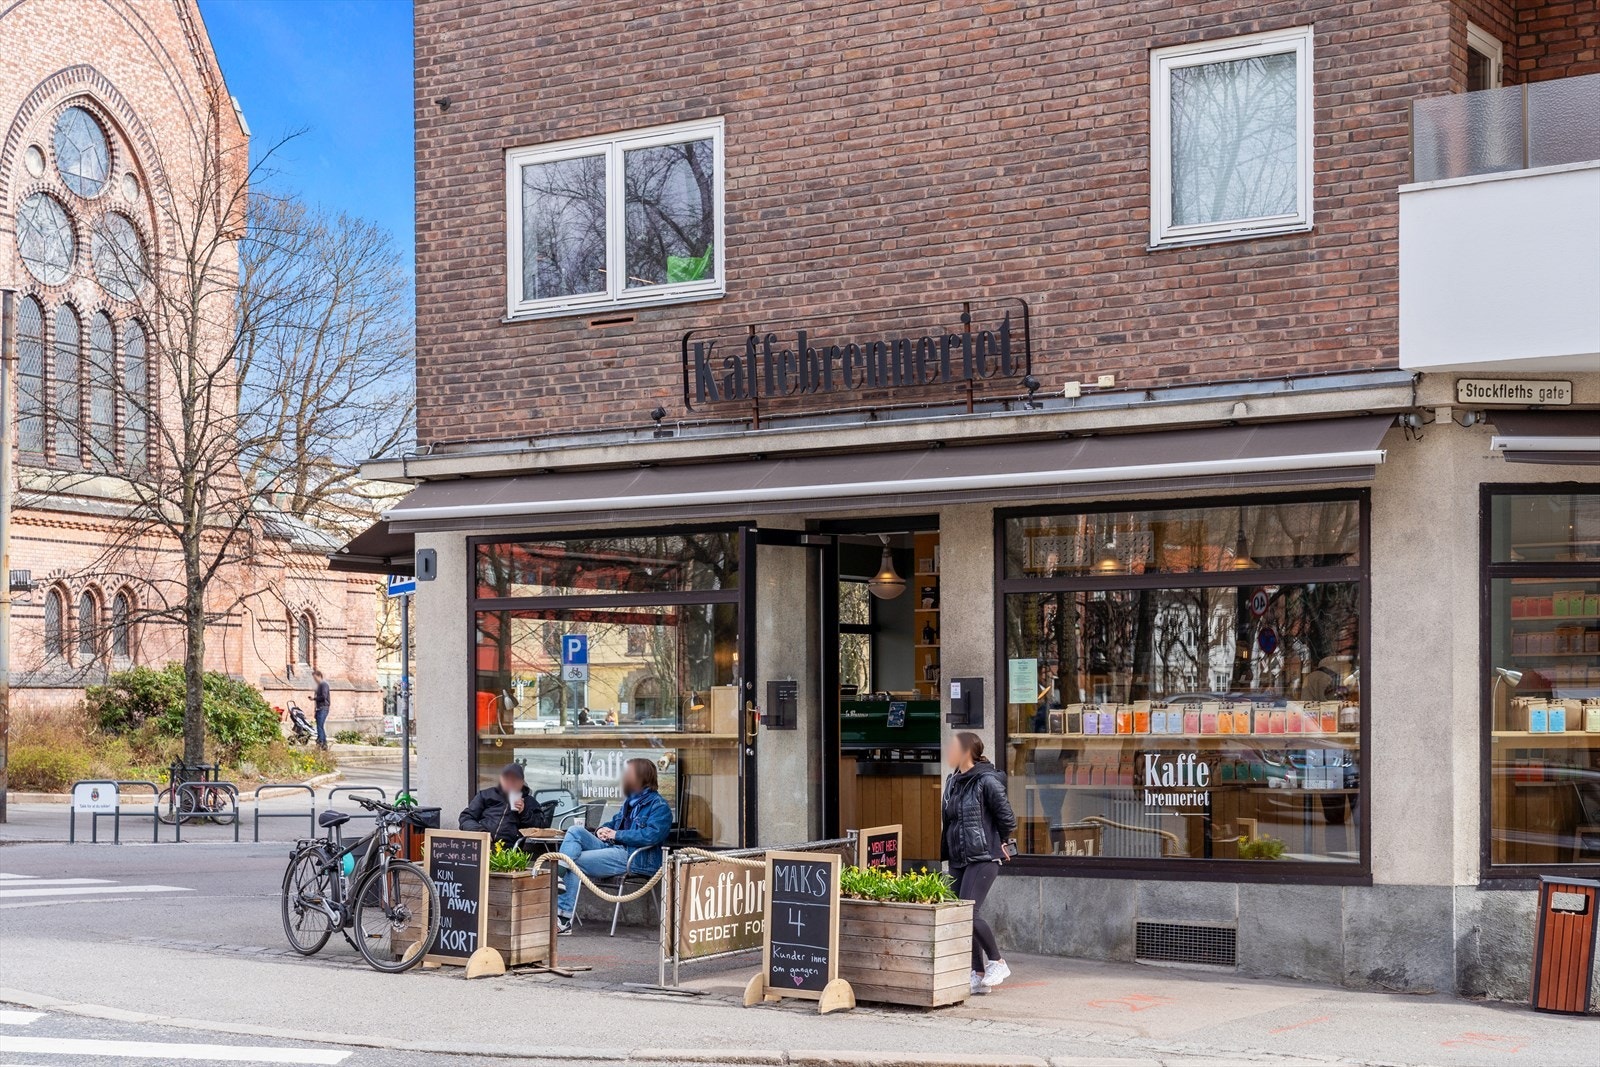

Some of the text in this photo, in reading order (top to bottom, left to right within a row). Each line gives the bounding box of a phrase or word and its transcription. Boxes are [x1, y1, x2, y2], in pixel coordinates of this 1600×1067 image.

[692, 310, 1019, 404] Kaffebrenneriet
[1466, 383, 1564, 402] Stockfleths gate
[568, 638, 582, 661] P
[1144, 753, 1209, 787] Kaffe
[1144, 789, 1210, 806] brenneriet
[437, 869, 454, 881] KUN
[774, 865, 827, 897] MAKS
[447, 897, 477, 914] AWAY
[688, 922, 739, 944] STEDET
[788, 907, 806, 937] 4
[440, 928, 477, 952] KORT
[772, 944, 827, 965] Kunder inne
[789, 967, 819, 978] gangen
